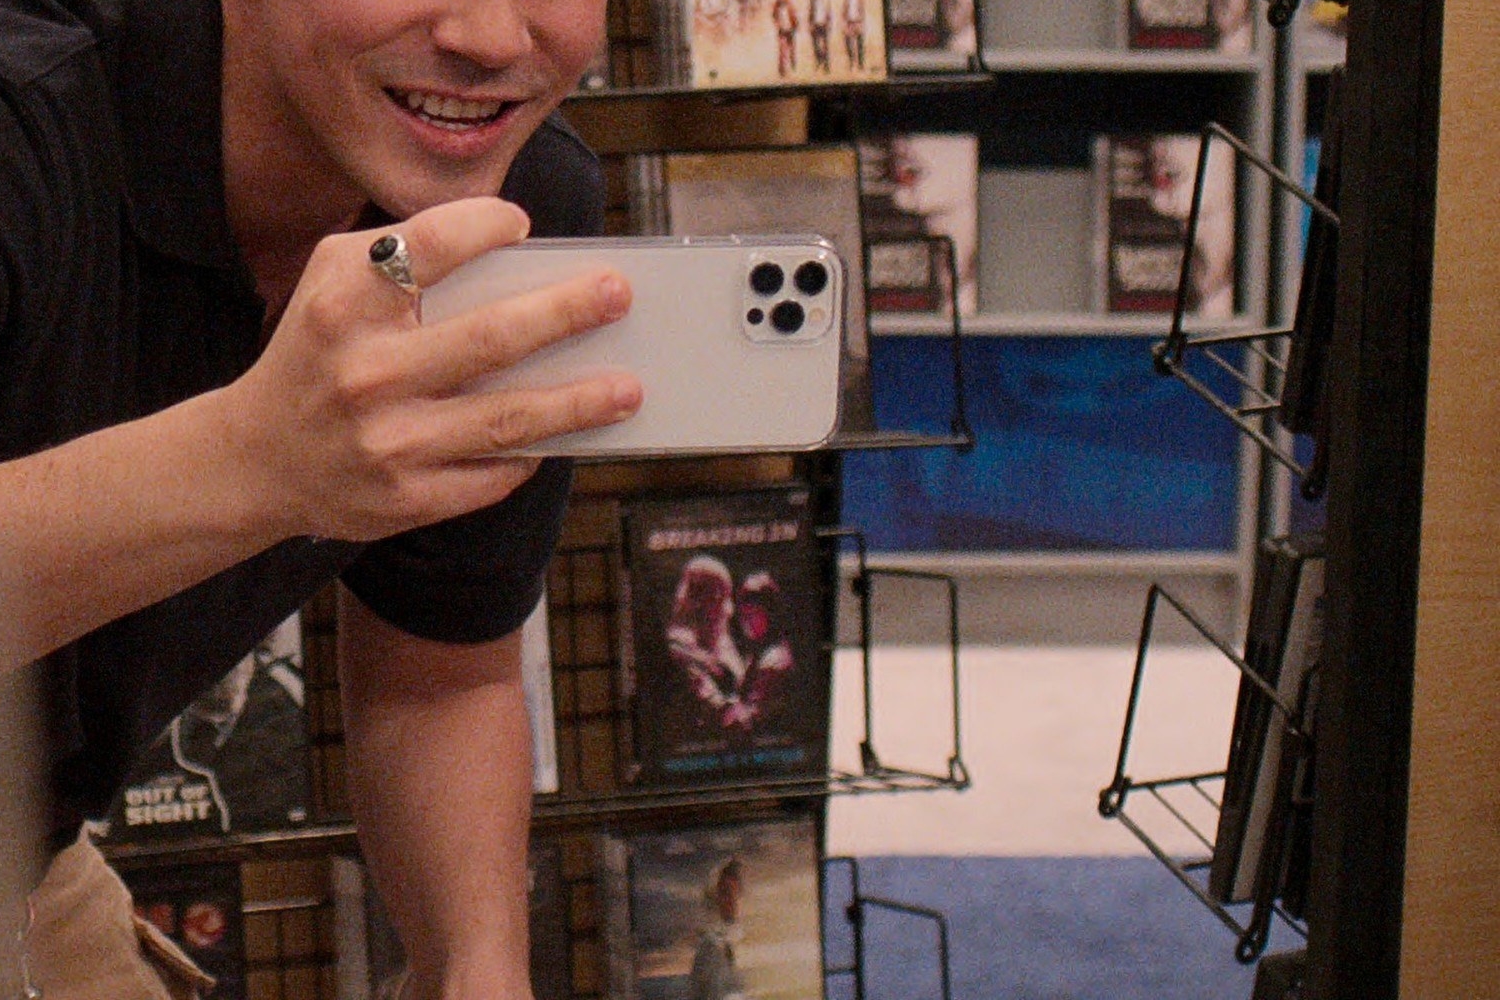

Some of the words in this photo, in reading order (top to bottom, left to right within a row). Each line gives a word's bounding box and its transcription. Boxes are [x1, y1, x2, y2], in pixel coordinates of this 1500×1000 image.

[125, 788, 175, 806] OUT
[180, 785, 209, 802] OF
[125, 801, 211, 826] SIGHT
